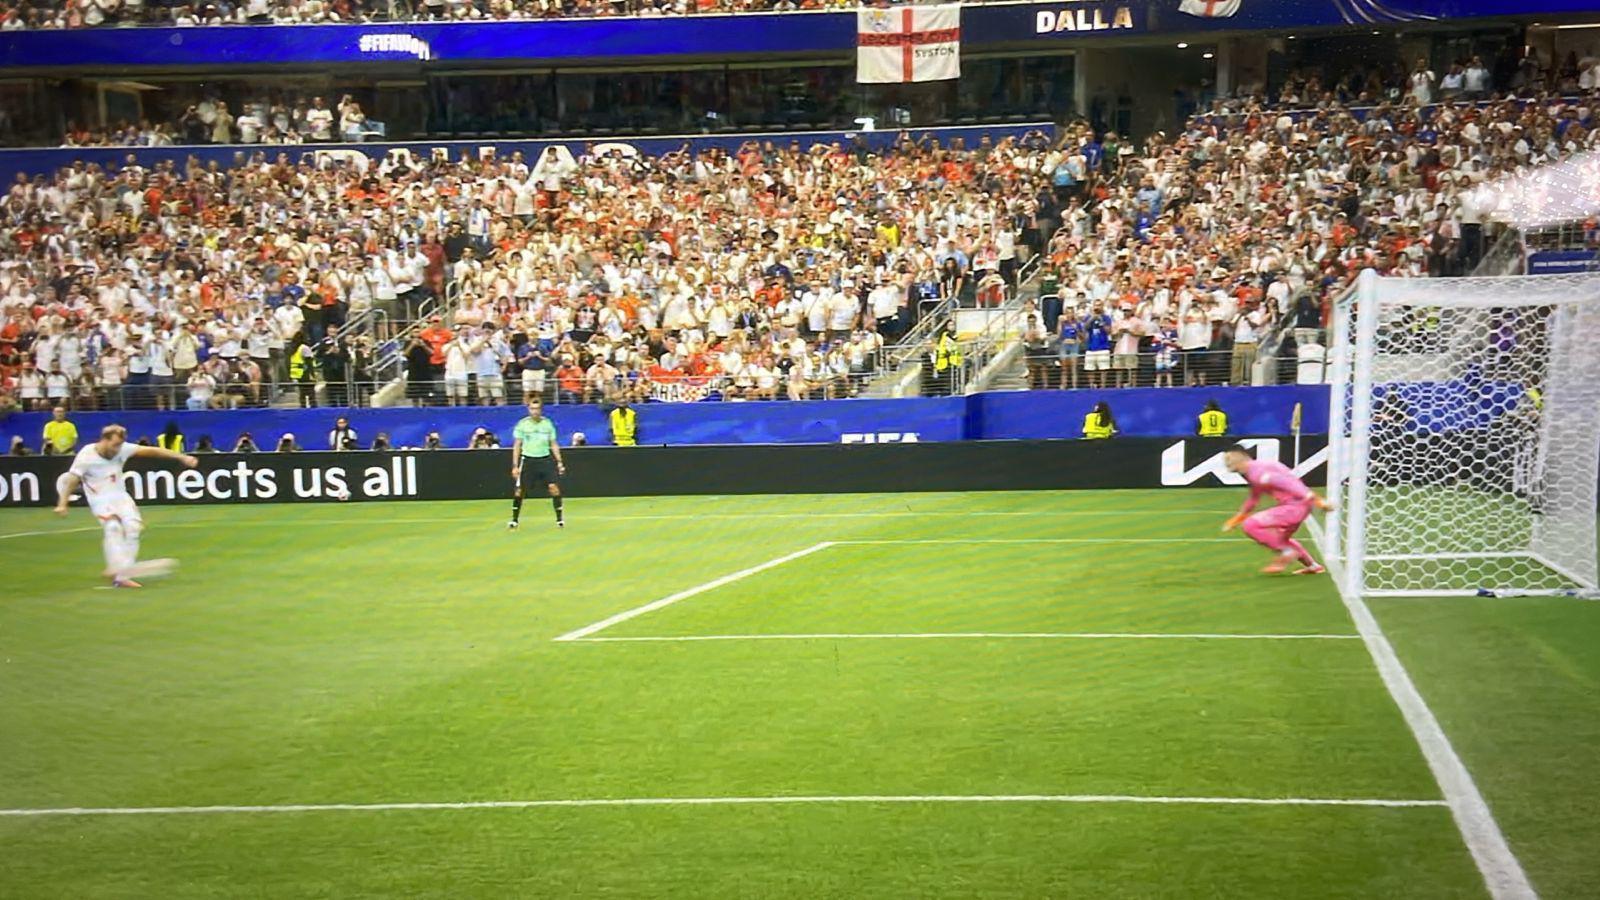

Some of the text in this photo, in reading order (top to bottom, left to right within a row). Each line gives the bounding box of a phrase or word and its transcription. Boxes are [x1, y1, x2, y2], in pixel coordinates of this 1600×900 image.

[1036, 8, 1133, 33] DALLA
[0, 455, 417, 503] n cnnects us all
